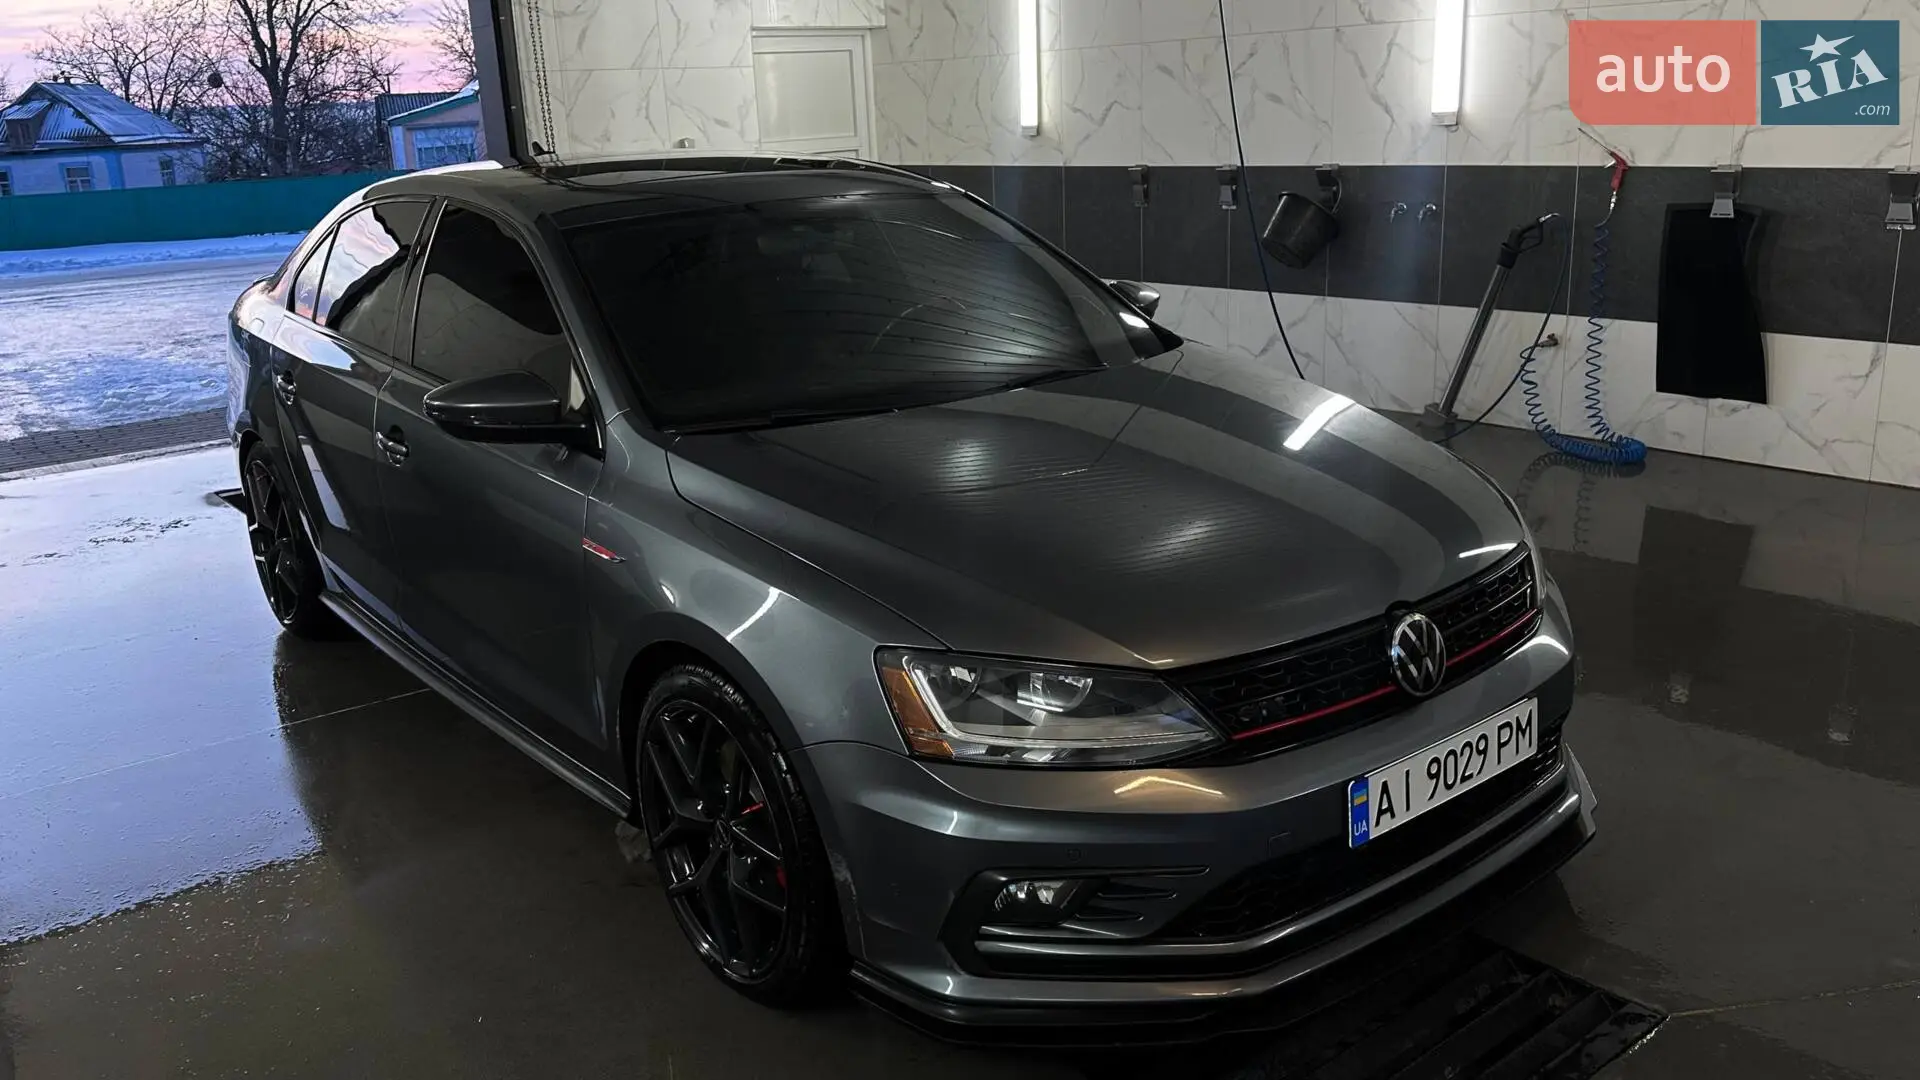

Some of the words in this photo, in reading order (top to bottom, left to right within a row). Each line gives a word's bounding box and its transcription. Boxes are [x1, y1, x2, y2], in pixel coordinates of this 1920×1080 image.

[1374, 768, 1411, 828] AI
[1426, 733, 1489, 801] 9029
[1497, 708, 1533, 766] PM
[1353, 819, 1368, 836] UA
